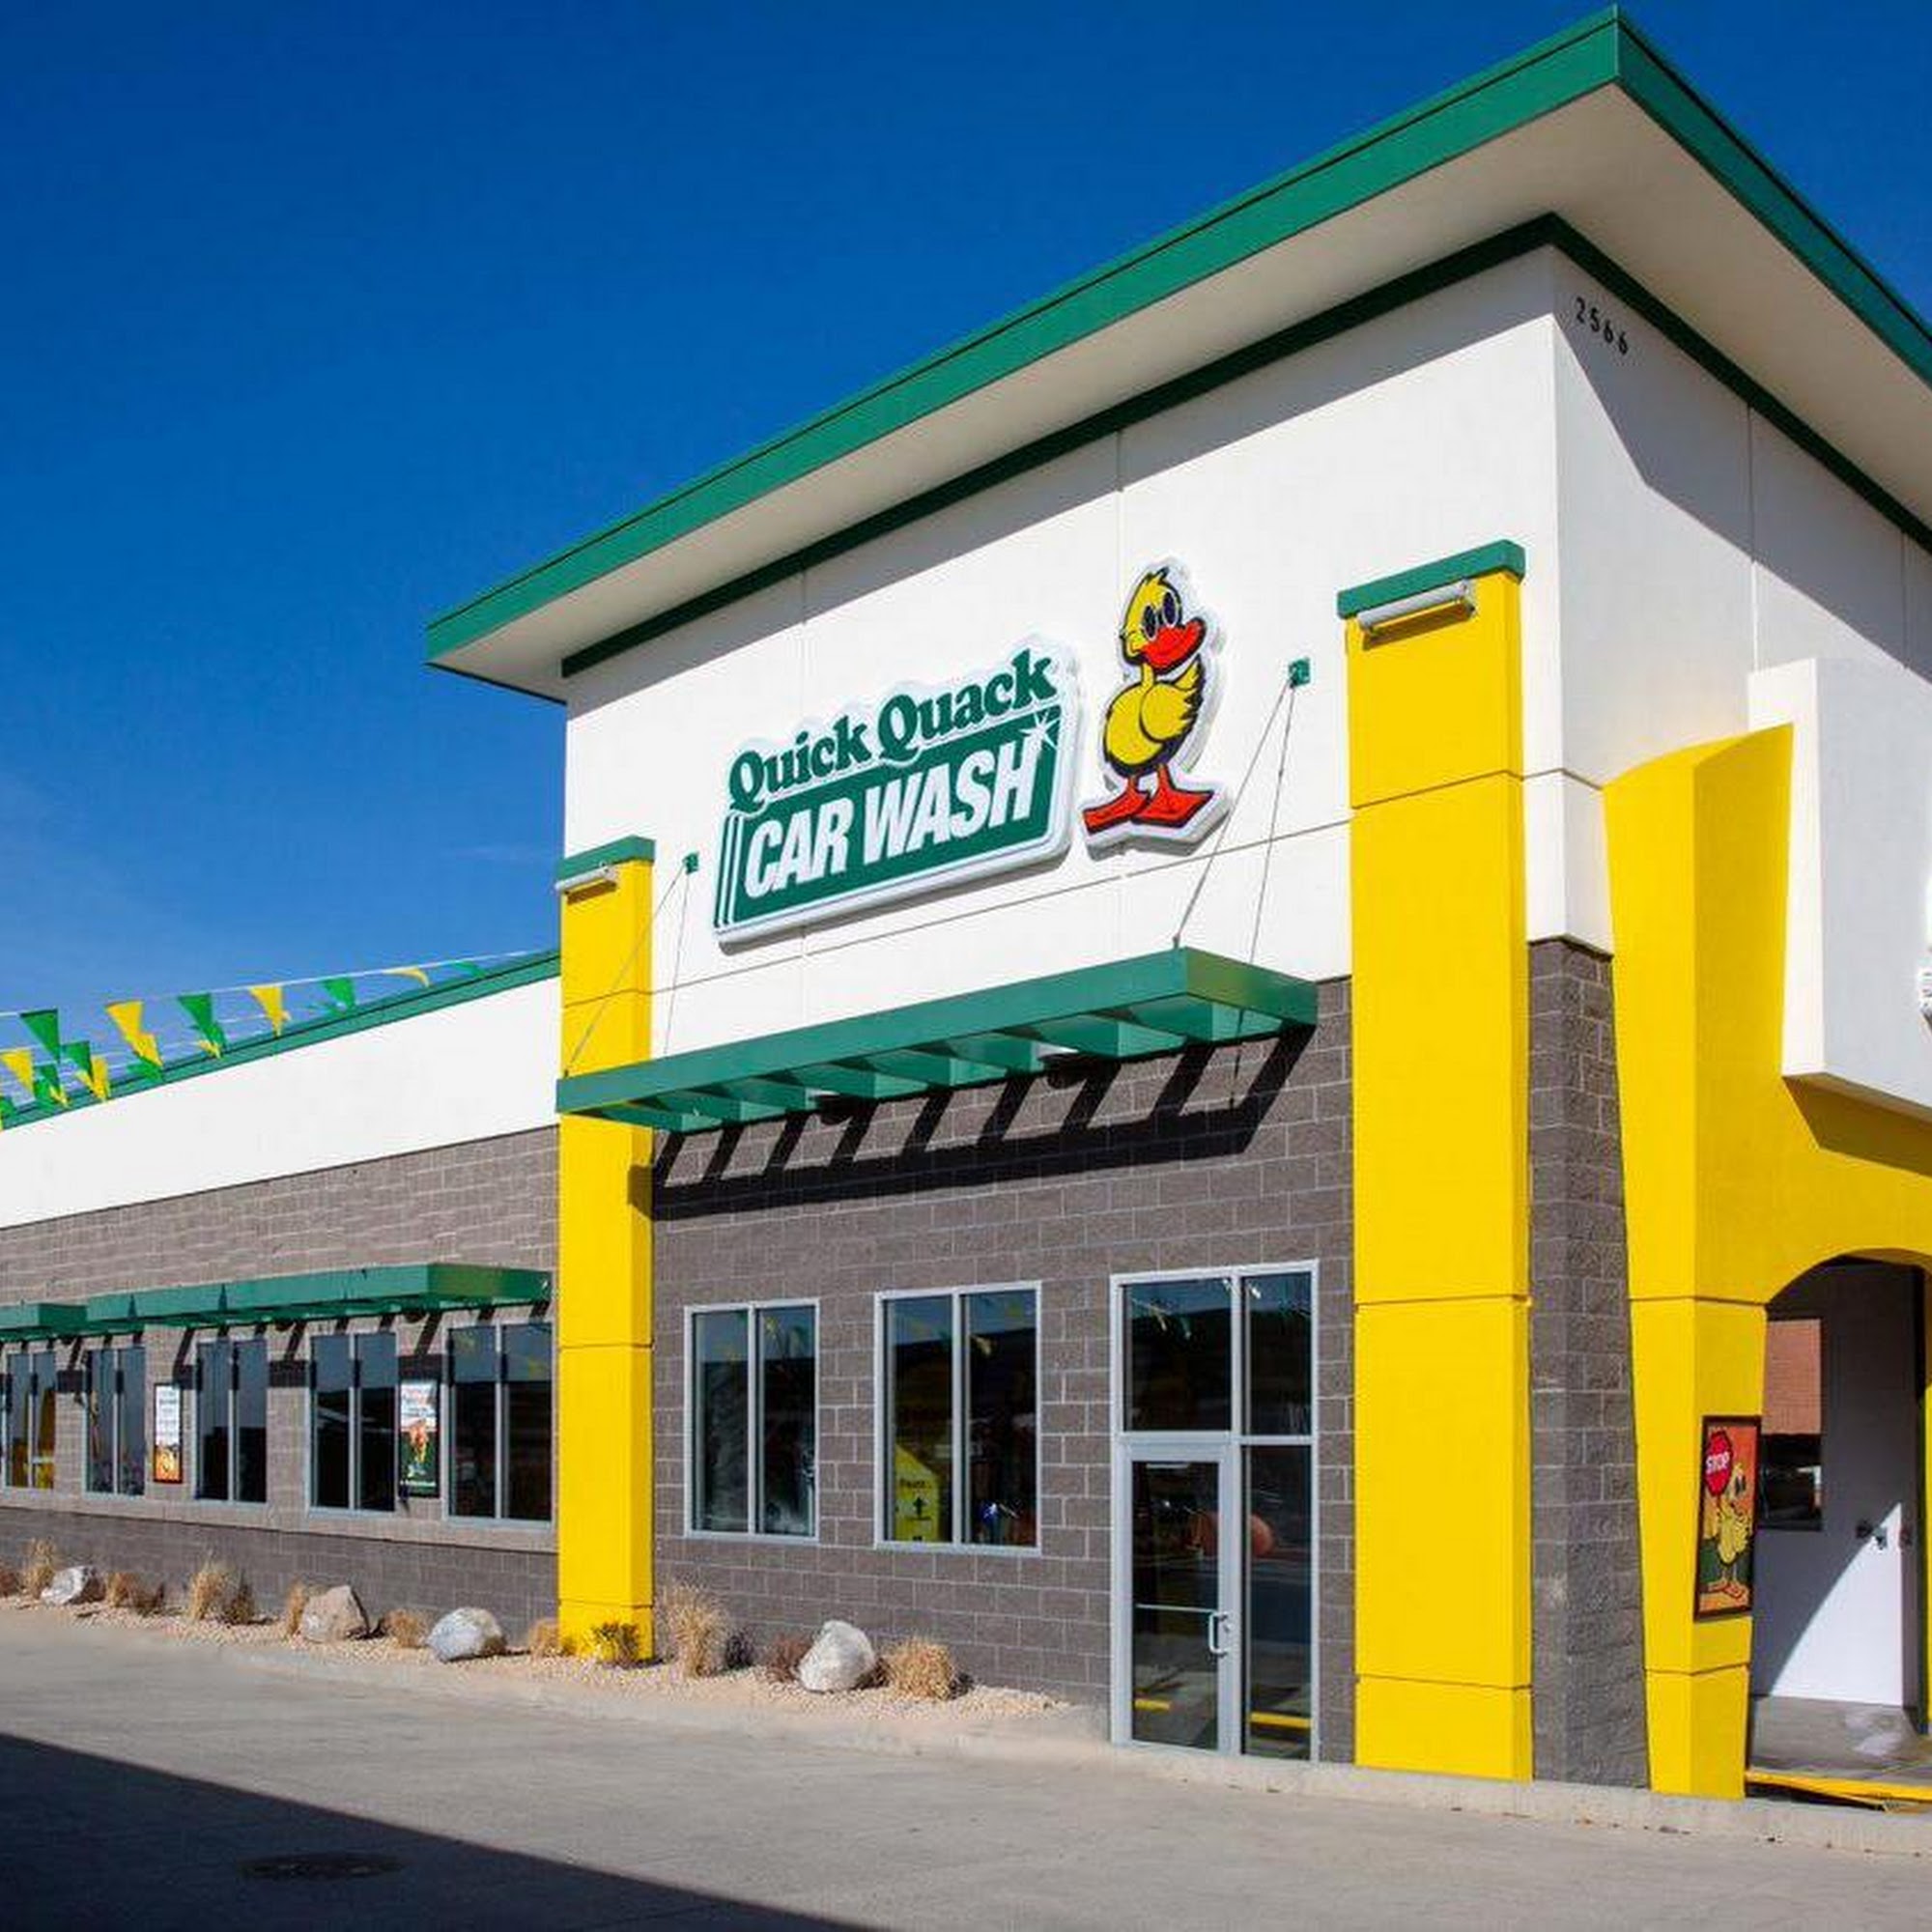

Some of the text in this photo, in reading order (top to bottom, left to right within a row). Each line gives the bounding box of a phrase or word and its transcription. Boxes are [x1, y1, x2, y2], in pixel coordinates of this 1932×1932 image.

[1576, 297, 1628, 355] 2566
[729, 648, 1058, 812] Quick Quack
[745, 734, 1041, 898] CAR WASH
[1706, 1451, 1730, 1474] STOP
